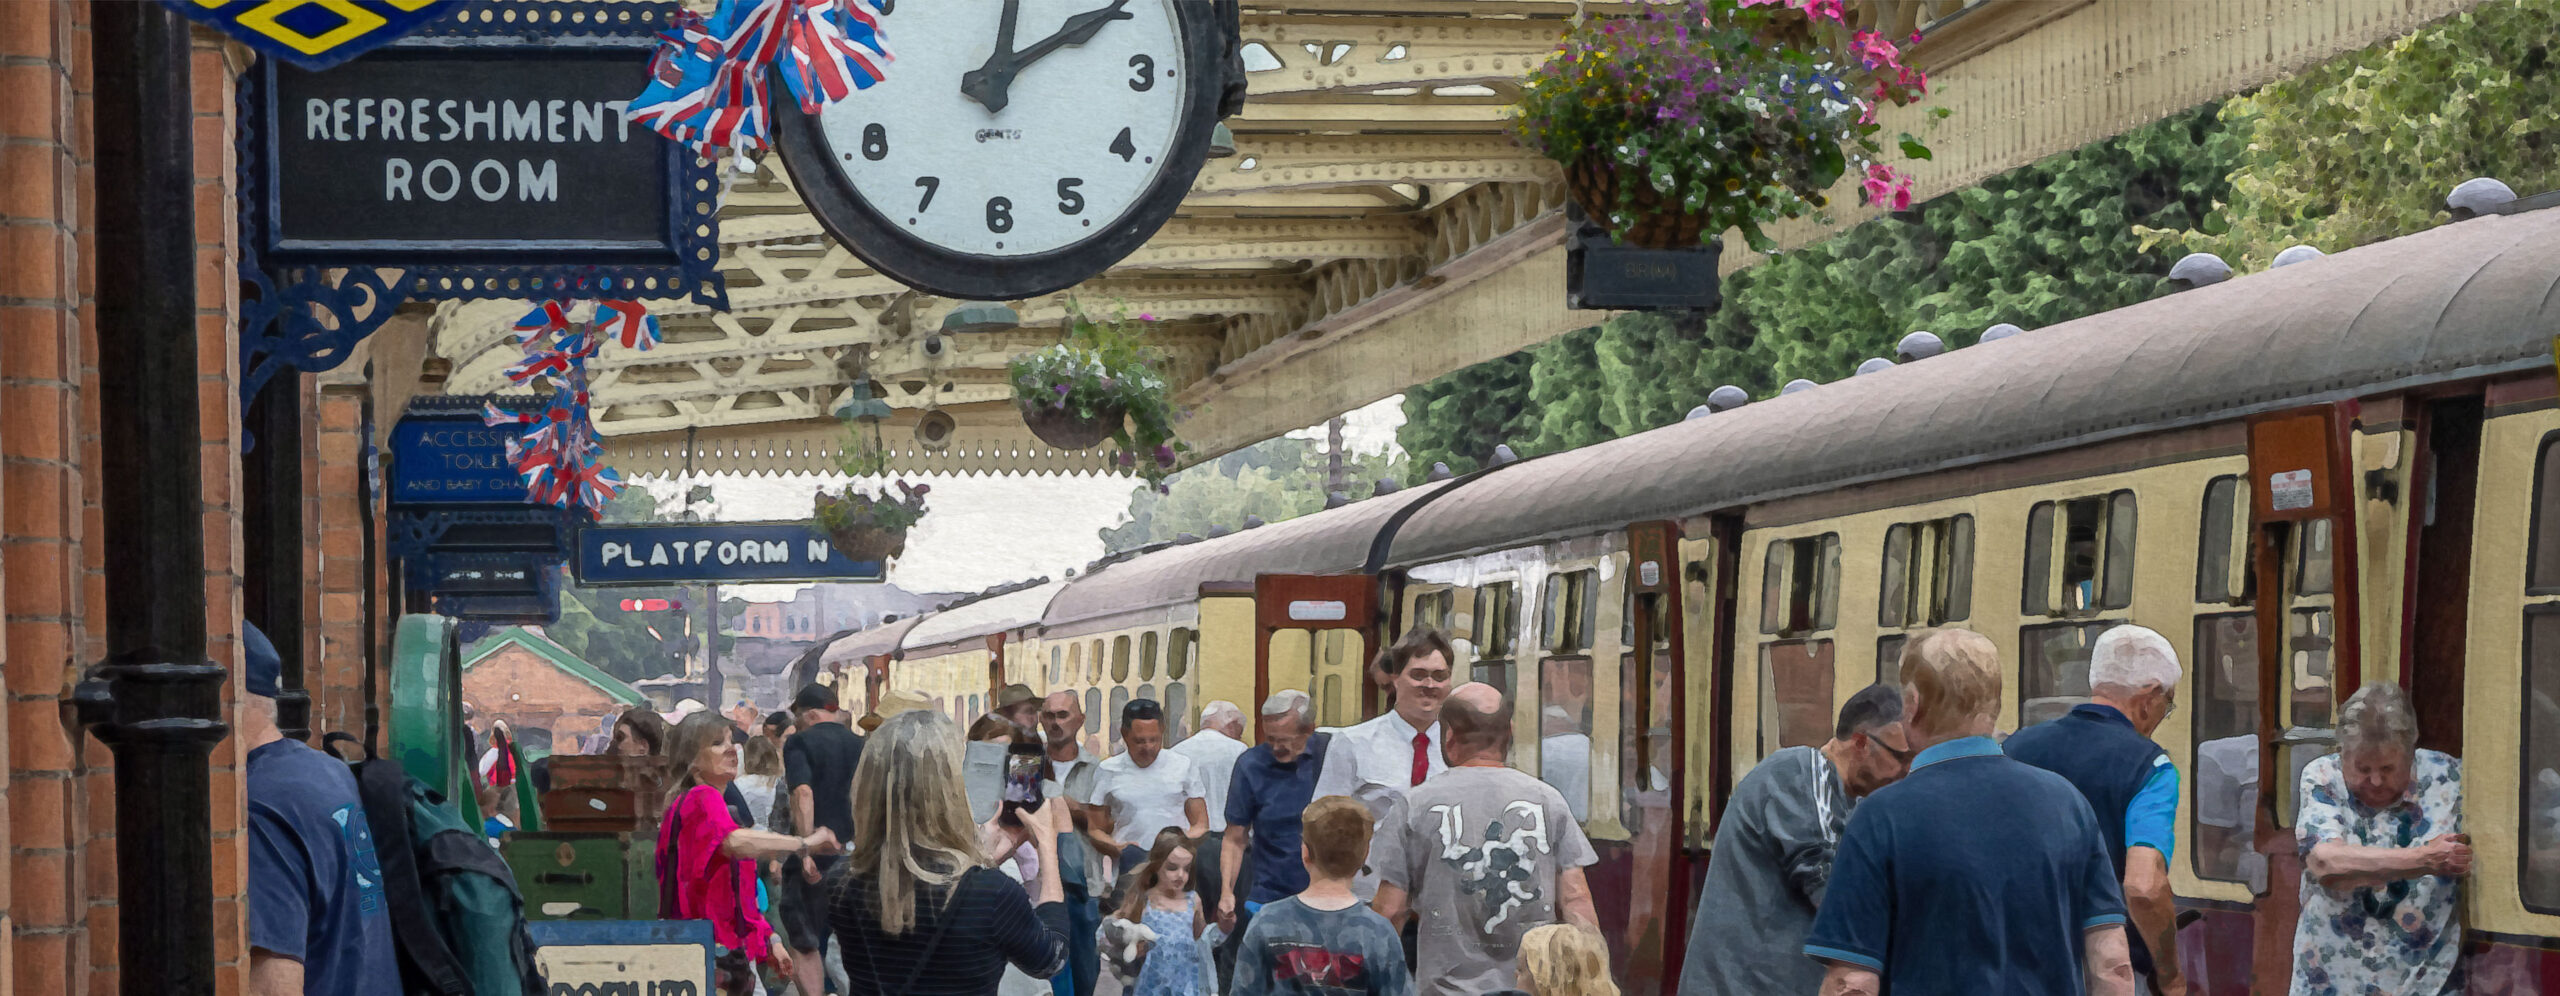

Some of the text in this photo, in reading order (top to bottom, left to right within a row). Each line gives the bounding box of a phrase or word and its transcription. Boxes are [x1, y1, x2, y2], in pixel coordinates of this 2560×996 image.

[1128, 53, 1154, 92] 3
[306, 98, 629, 142] REFRESHMENT
[861, 122, 888, 161] 8
[1108, 126, 1136, 162] 4
[386, 158, 558, 202] ROOM
[915, 176, 940, 213] 7
[1057, 177, 1085, 215] 5
[985, 195, 1013, 234] 6
[419, 431, 524, 447] ACCESSI
[442, 453, 511, 470] TOILE
[446, 480, 482, 491] BABY
[601, 540, 789, 567] PLATFORM
